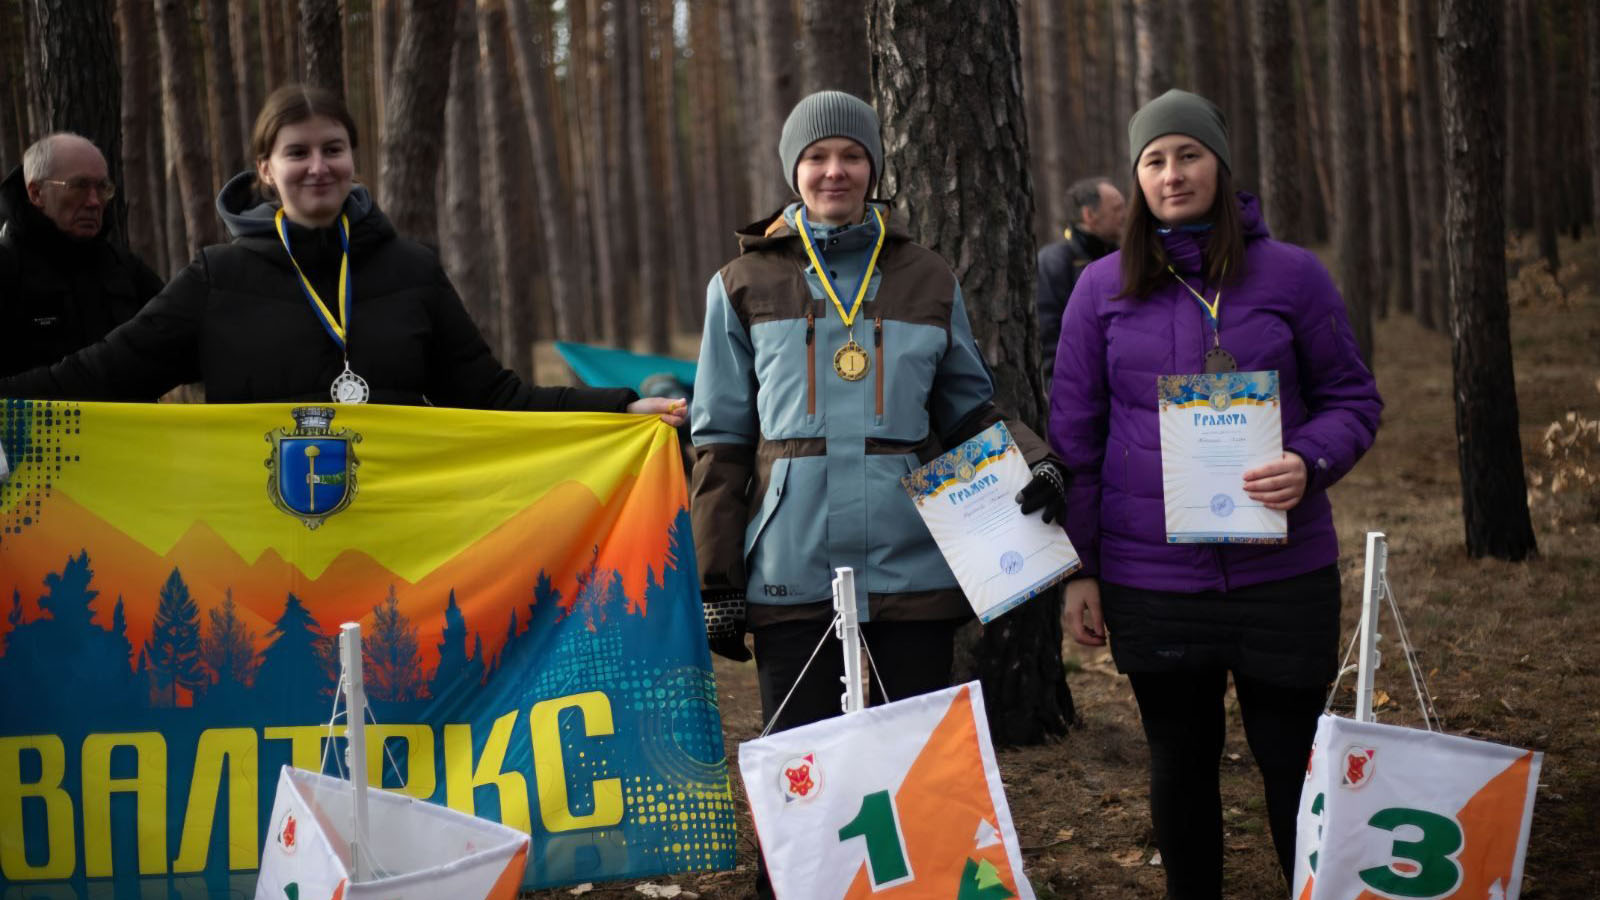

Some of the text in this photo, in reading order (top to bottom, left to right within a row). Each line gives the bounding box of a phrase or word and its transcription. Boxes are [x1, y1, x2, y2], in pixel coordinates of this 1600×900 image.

[344, 383, 358, 402] 2
[838, 789, 909, 886] 1
[1358, 807, 1463, 898] 3
